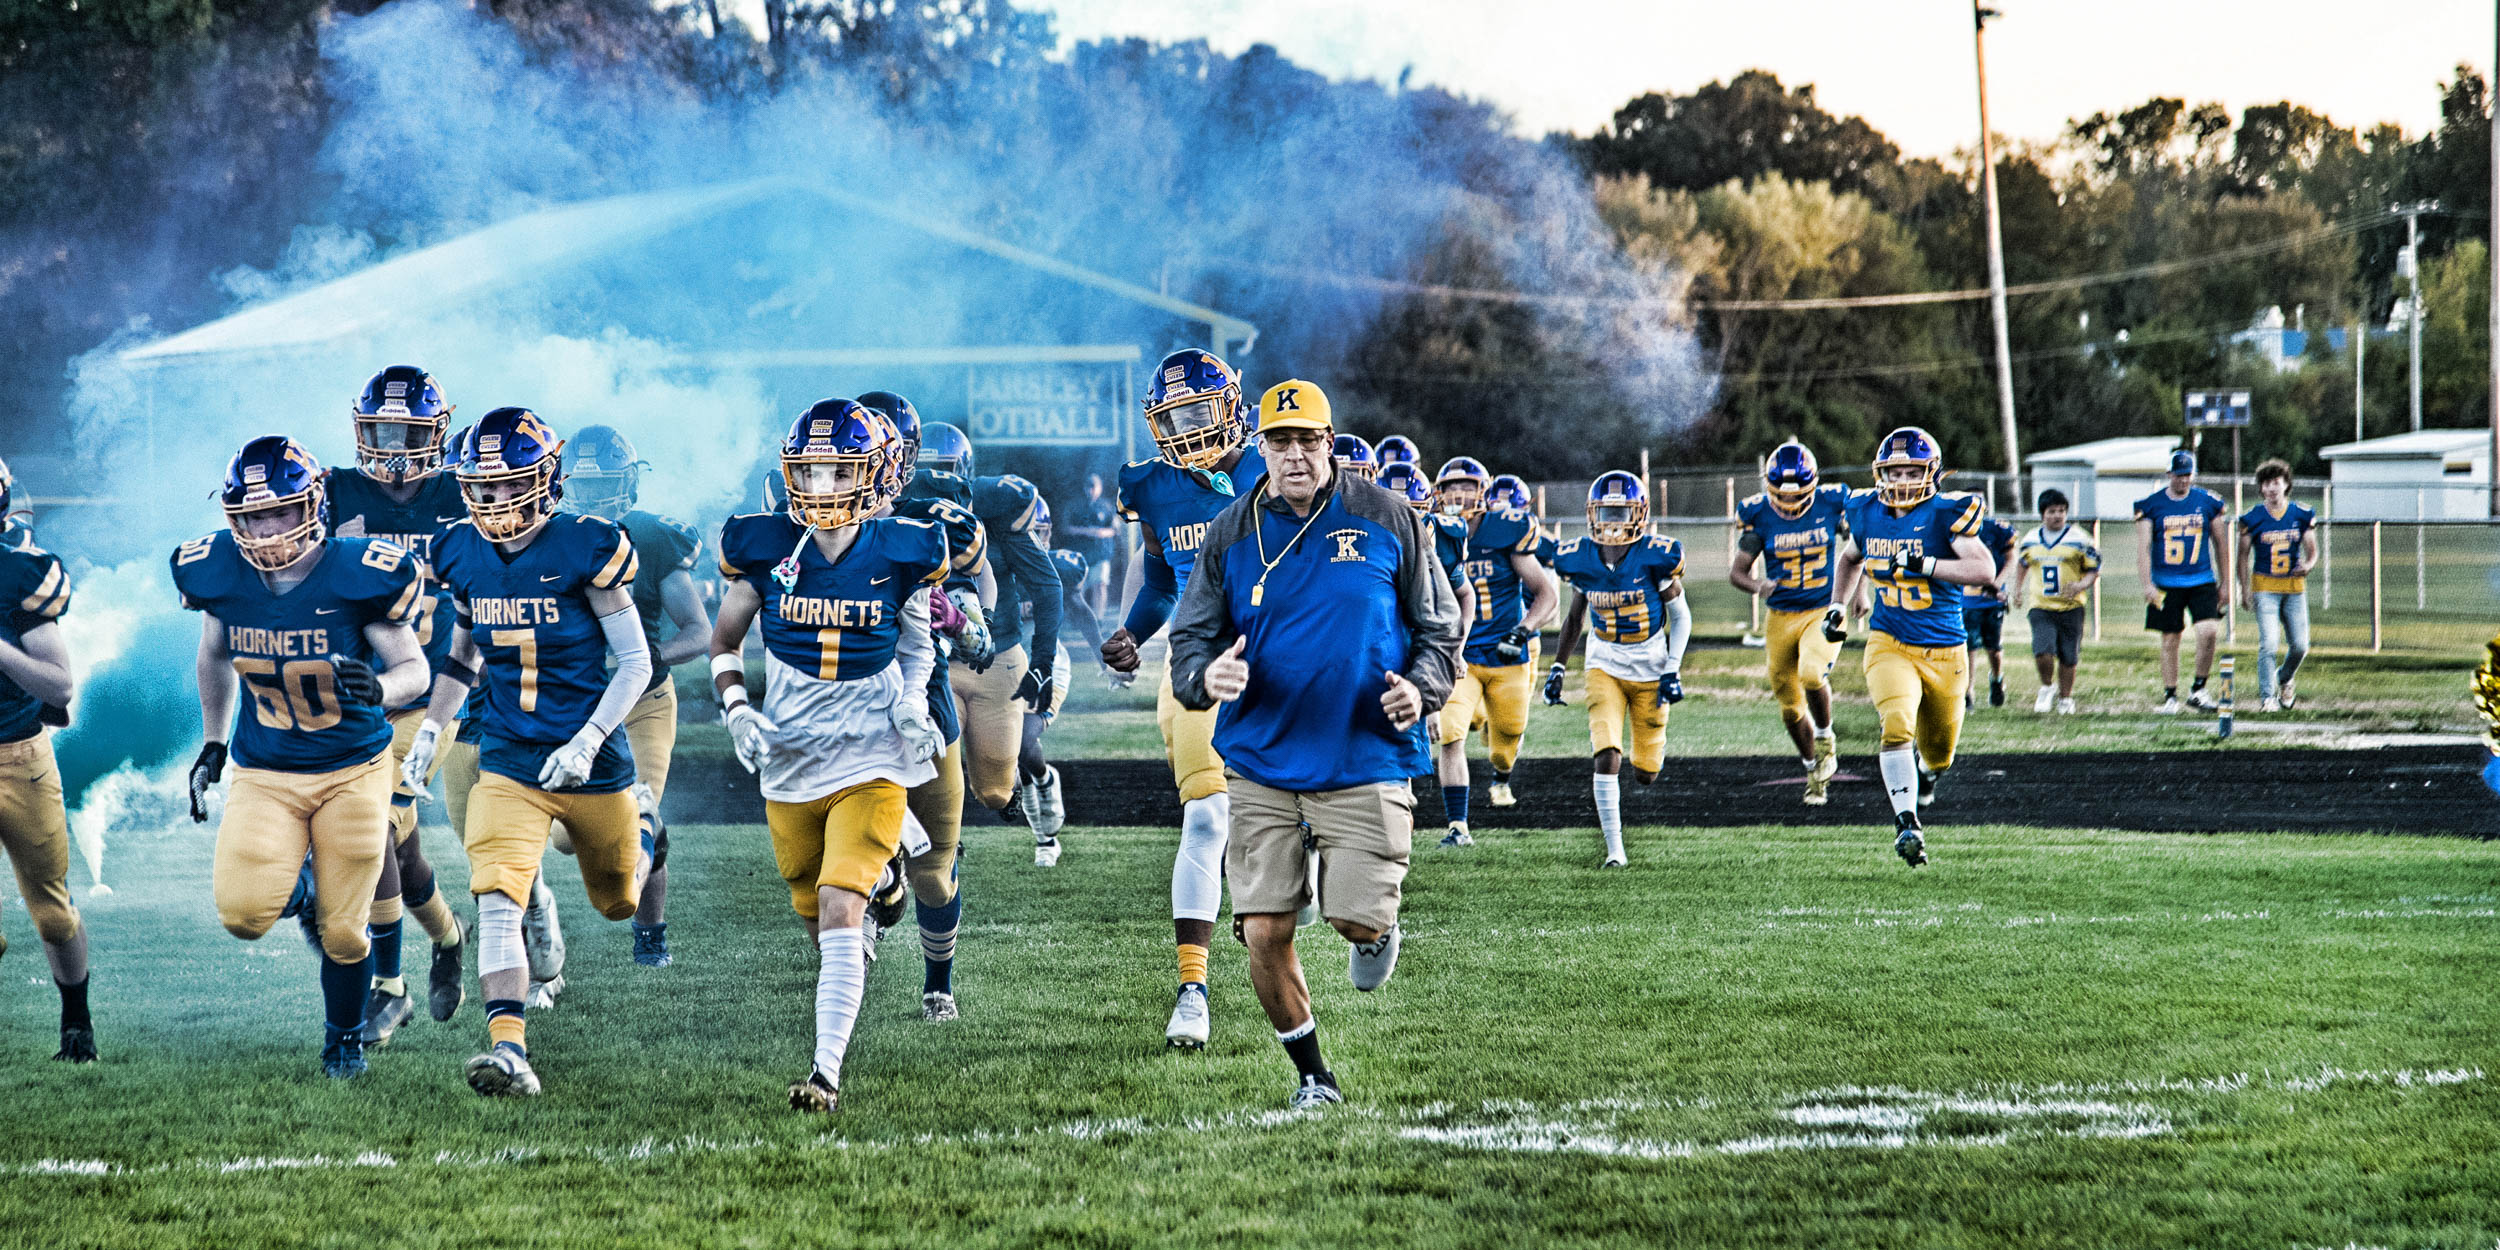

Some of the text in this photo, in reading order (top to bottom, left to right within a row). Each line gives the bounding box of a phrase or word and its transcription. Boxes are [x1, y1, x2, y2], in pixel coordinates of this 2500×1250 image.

[1276, 389, 1299, 412] K
[976, 406, 1107, 435] OTBALL
[1169, 522, 1211, 551] HOR
[1337, 536, 1359, 557] K
[1774, 527, 1829, 549] HORNETS
[1866, 538, 1923, 557] HORNETS
[2163, 527, 2203, 565] 67
[1463, 559, 1493, 578] ETS
[1775, 545, 1829, 590] 32
[2271, 543, 2290, 576] 6
[2042, 566, 2060, 595] 9
[471, 598, 560, 625] HORNETS
[779, 593, 883, 627] HORNETS
[1472, 577, 1493, 621] 1
[1587, 589, 1645, 609] HORNETS
[1594, 603, 1649, 644] 33
[229, 626, 328, 656] HORNETS
[817, 628, 841, 681] 1
[491, 628, 538, 713] 7
[232, 656, 342, 732] 60
